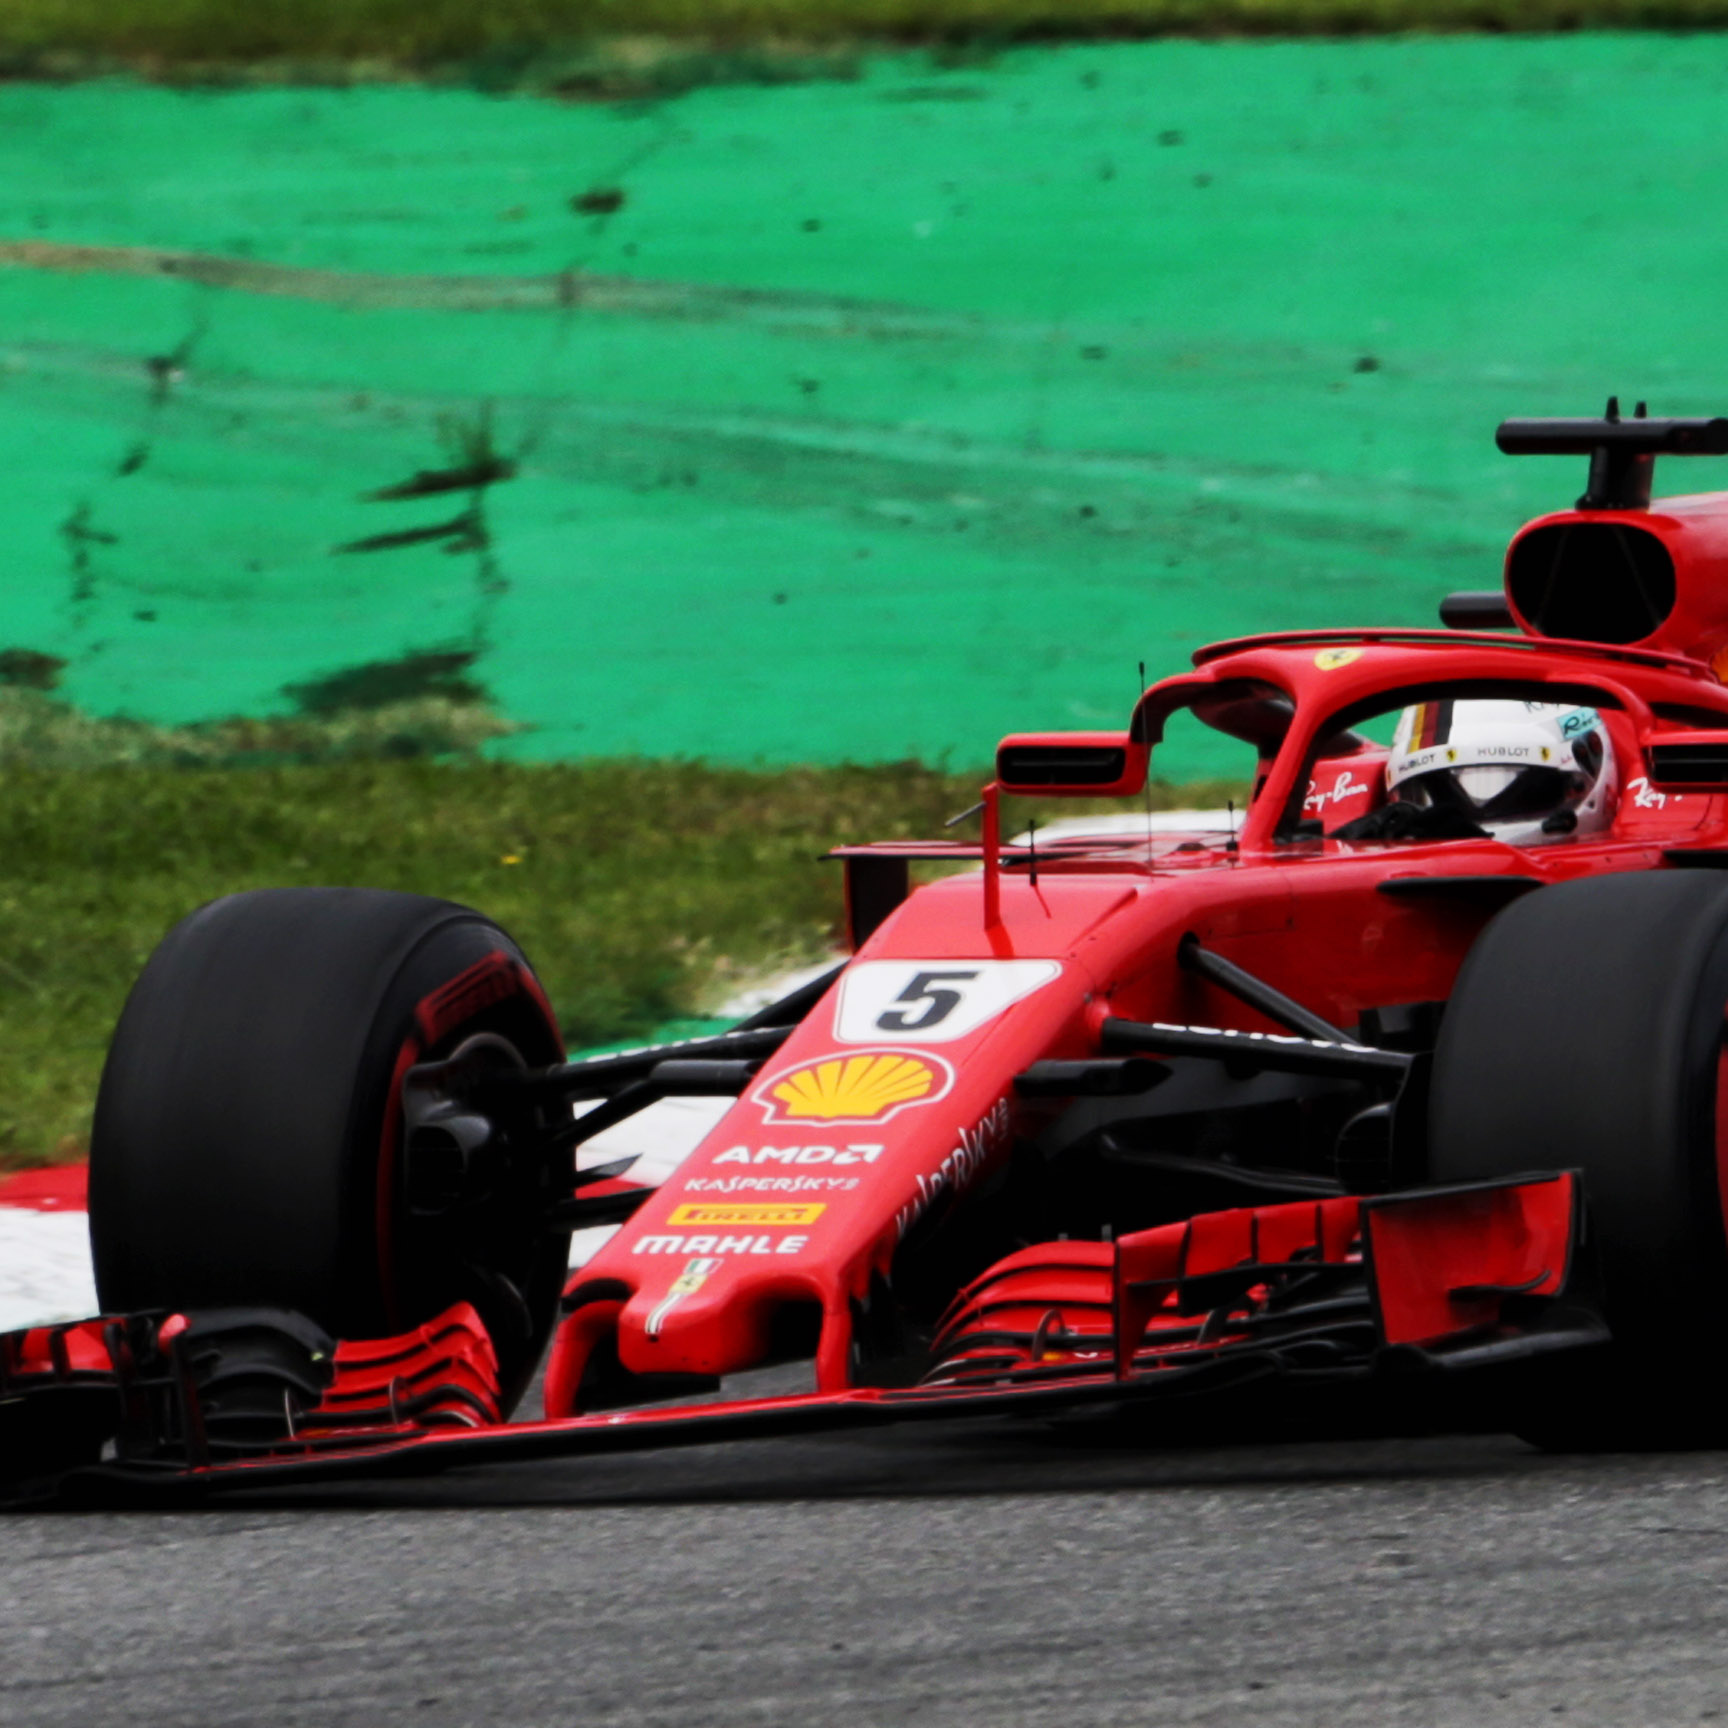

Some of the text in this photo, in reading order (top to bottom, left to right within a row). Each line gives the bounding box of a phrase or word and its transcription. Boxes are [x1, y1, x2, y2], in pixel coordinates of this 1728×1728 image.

[1477, 747, 1530, 758] HUBLOT
[875, 970, 984, 1032] 5
[712, 1145, 837, 1164] AMD
[684, 1175, 846, 1193] KASPERSKY
[632, 1235, 810, 1255] MAHLE
